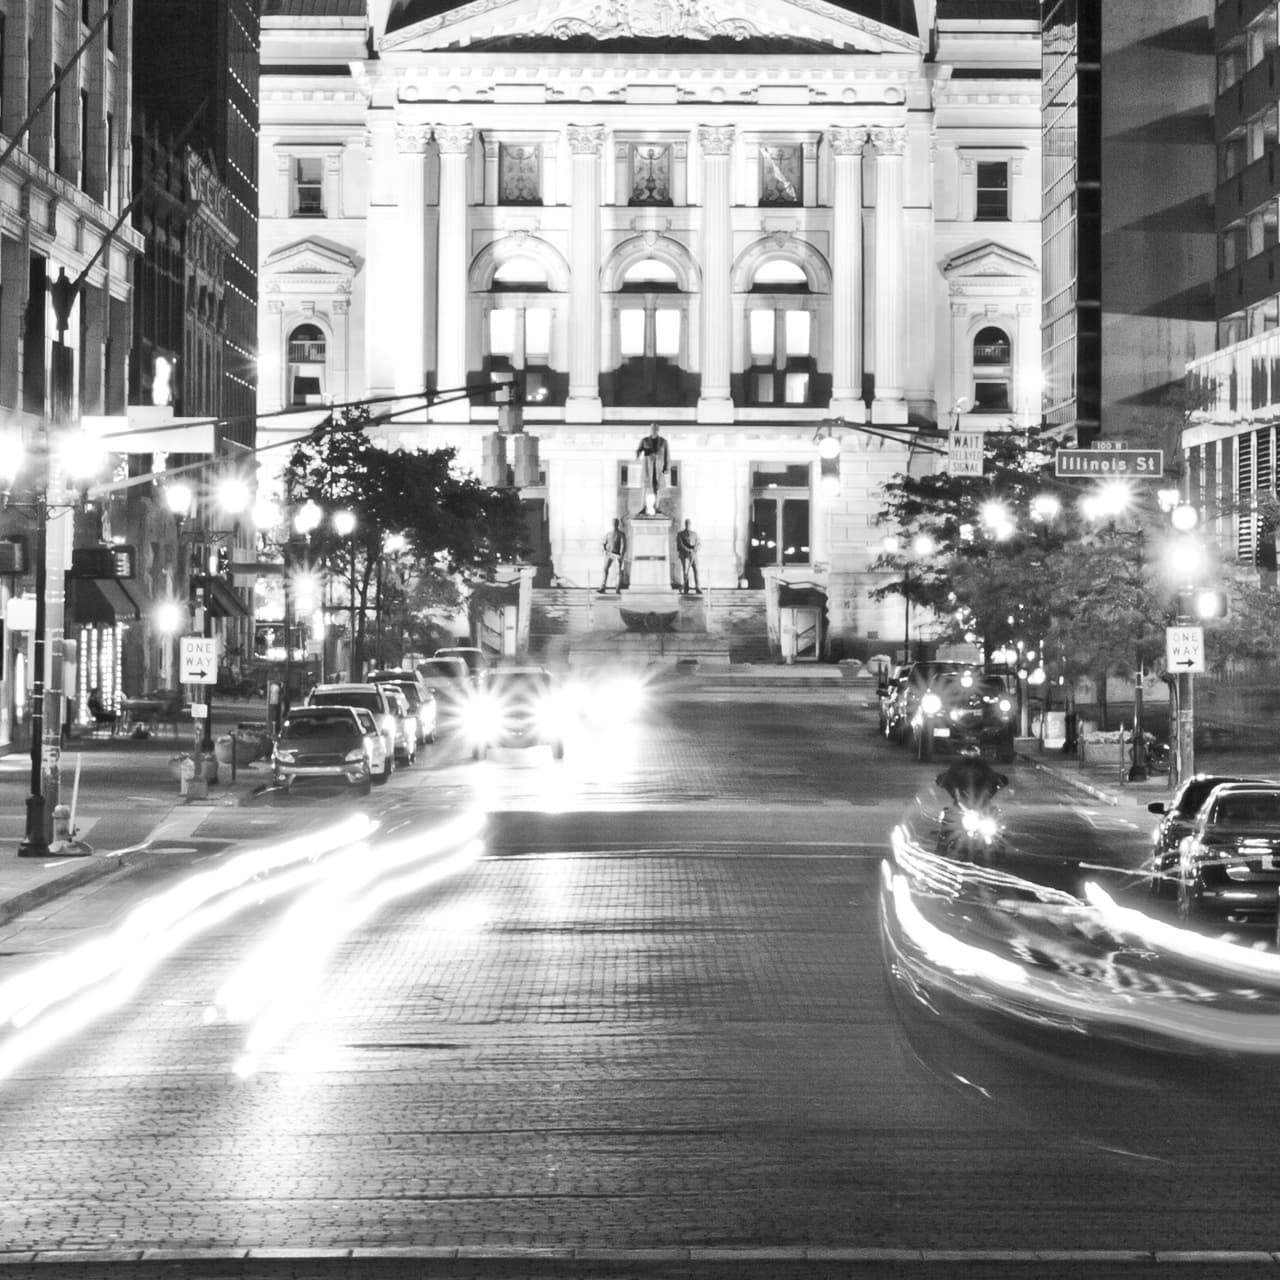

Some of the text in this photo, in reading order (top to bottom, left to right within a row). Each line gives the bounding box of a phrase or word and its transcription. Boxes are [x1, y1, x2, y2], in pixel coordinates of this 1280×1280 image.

[953, 435, 979, 449] WAIT
[950, 449, 982, 461] DELAYED
[952, 462, 979, 473] SIGNAL
[1062, 456, 1155, 471] Illinois St
[1173, 631, 1198, 642] ONE
[186, 642, 212, 653] ONE
[1172, 646, 1200, 656] WAY
[185, 656, 214, 667] WAY
